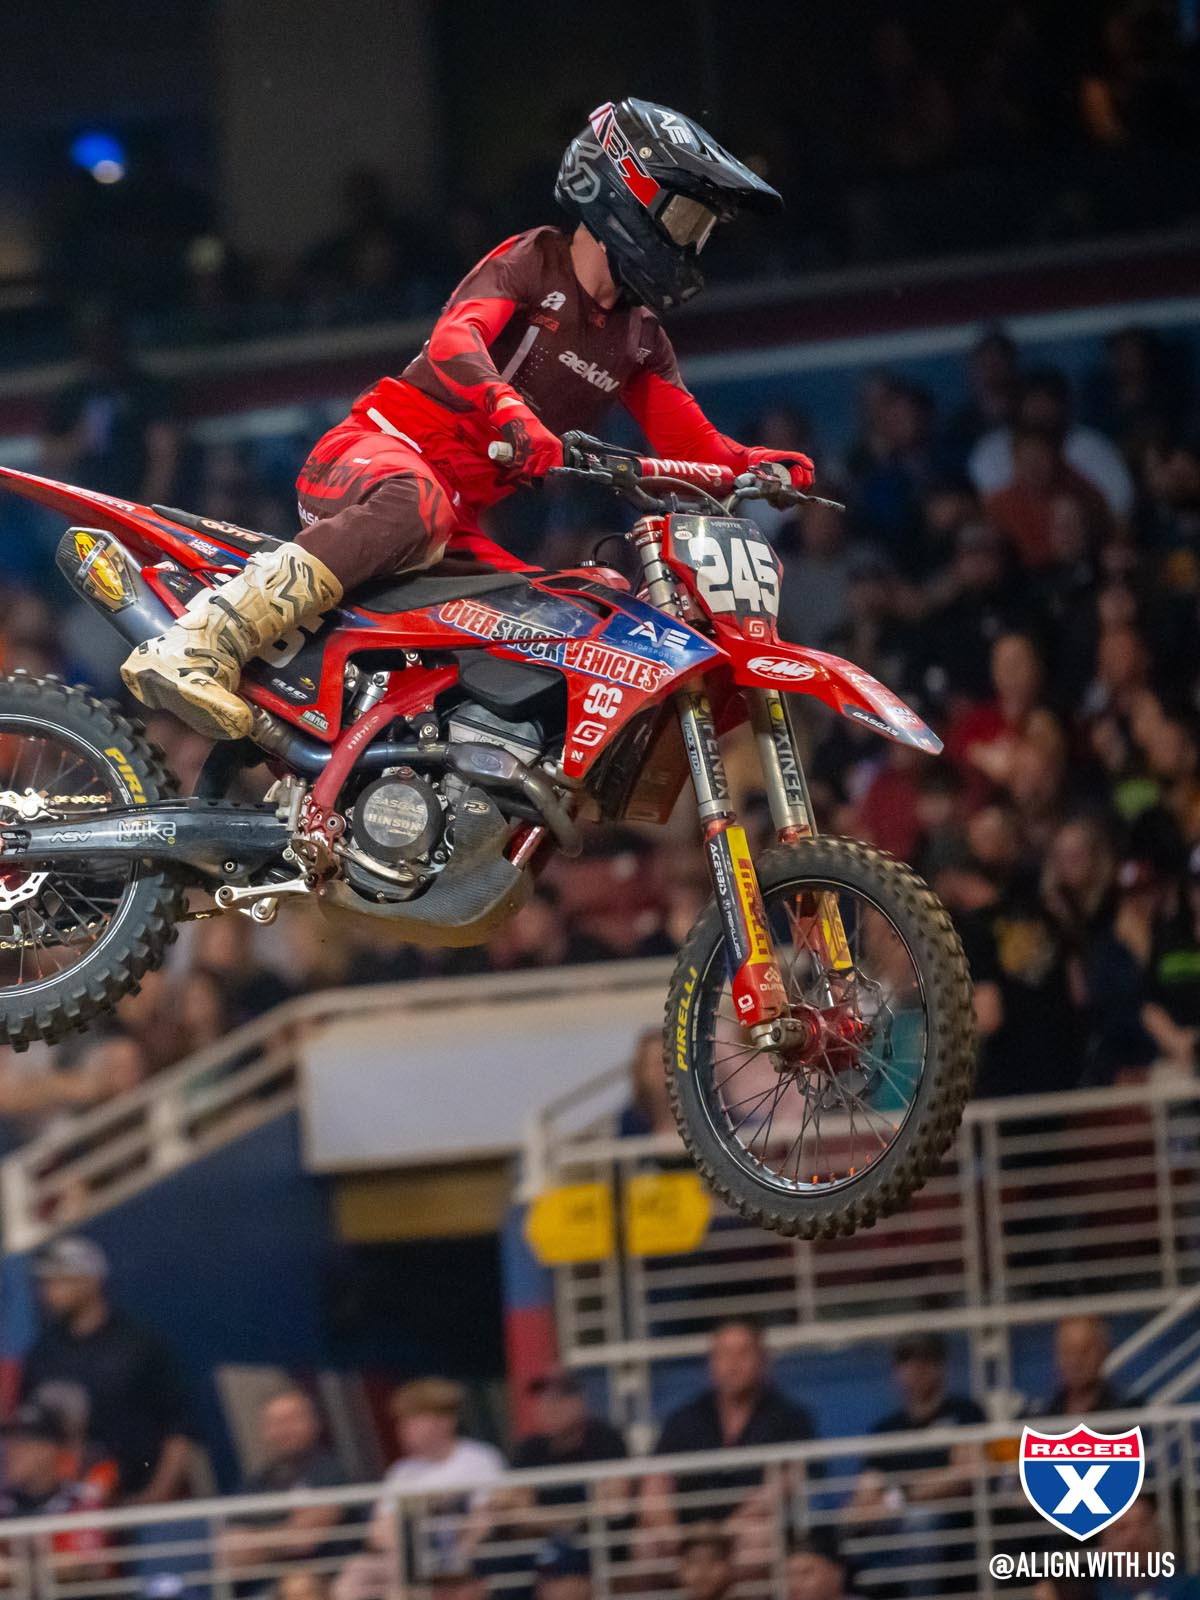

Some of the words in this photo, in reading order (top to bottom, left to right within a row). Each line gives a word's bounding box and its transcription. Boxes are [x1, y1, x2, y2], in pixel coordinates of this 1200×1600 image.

[688, 537, 780, 617] 245
[439, 599, 559, 663] OVERSTOCK
[563, 640, 664, 693] VEHICLES
[747, 659, 815, 679] FMF
[852, 711, 899, 737] GASGAS
[676, 965, 699, 1072] PIRELLI
